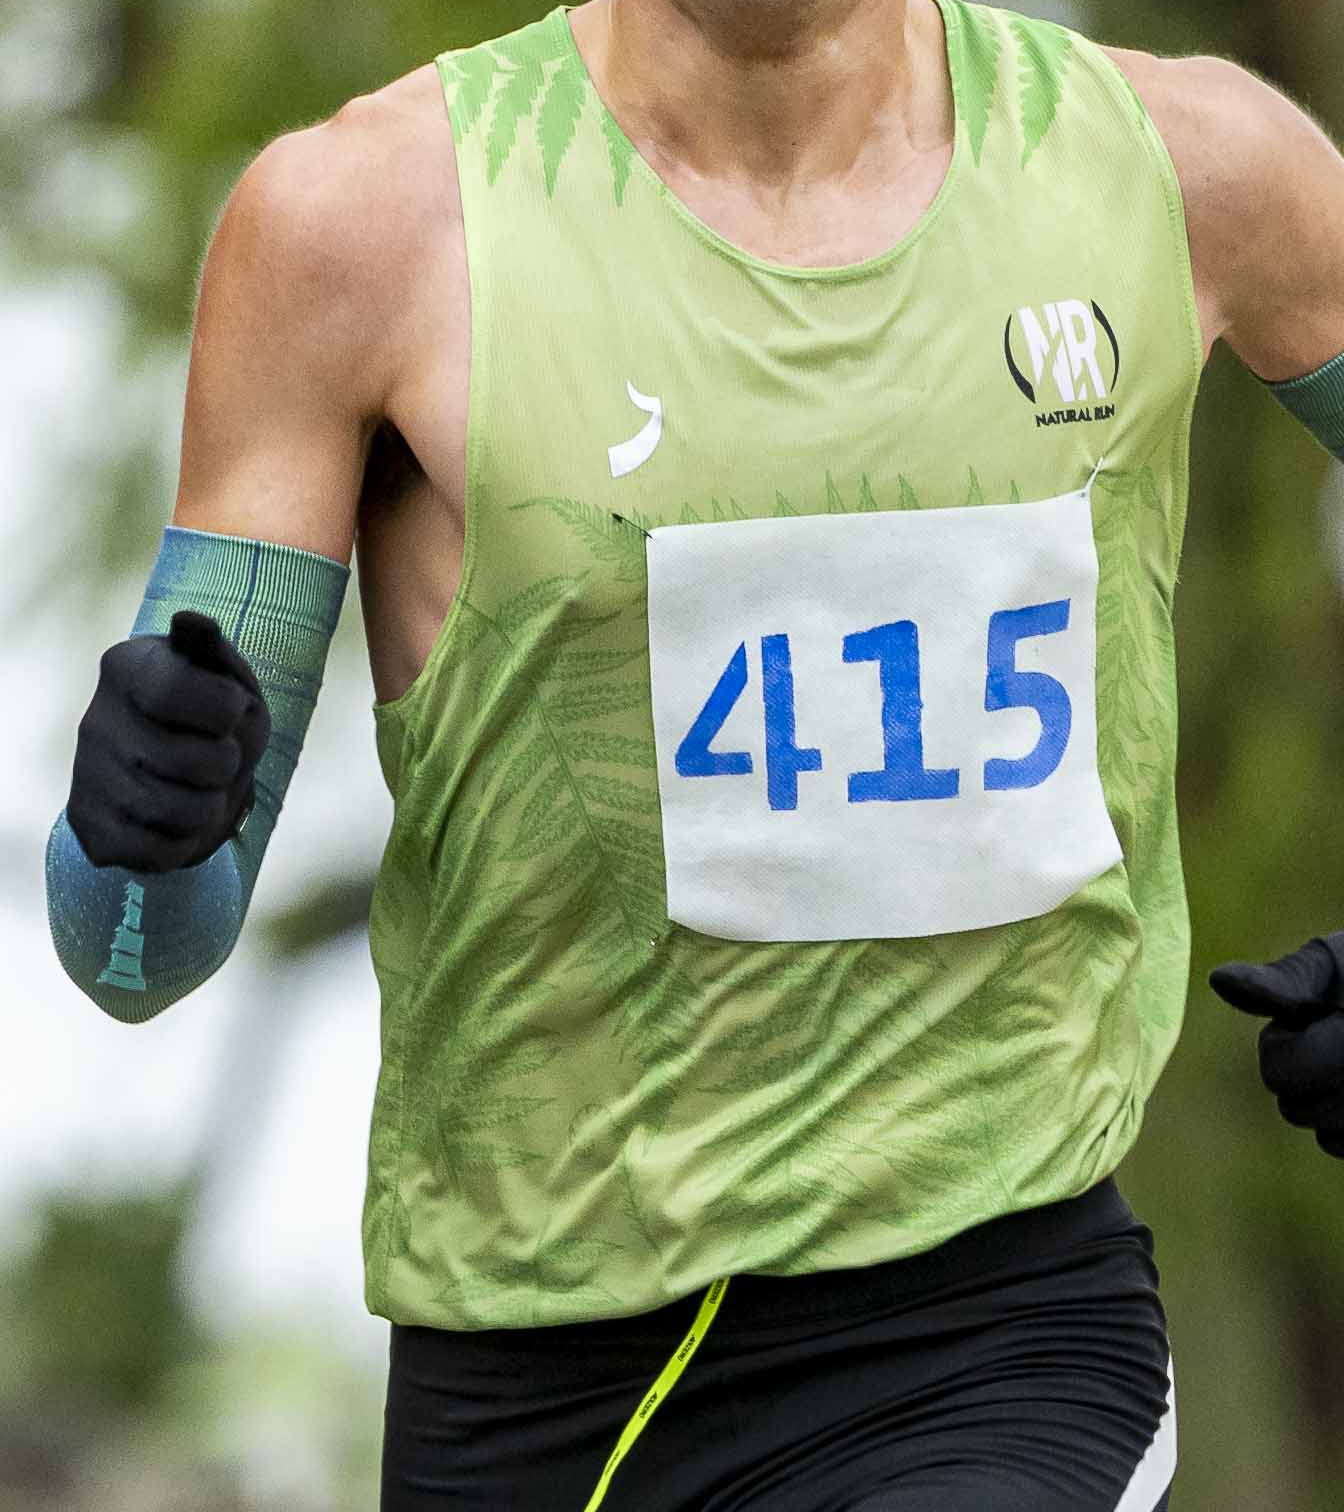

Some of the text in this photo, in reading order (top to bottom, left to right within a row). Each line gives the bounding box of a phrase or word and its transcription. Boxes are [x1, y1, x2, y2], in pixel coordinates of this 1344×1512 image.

[1035, 404, 1115, 427] NATURAL RUN
[675, 598, 1072, 810] 415
